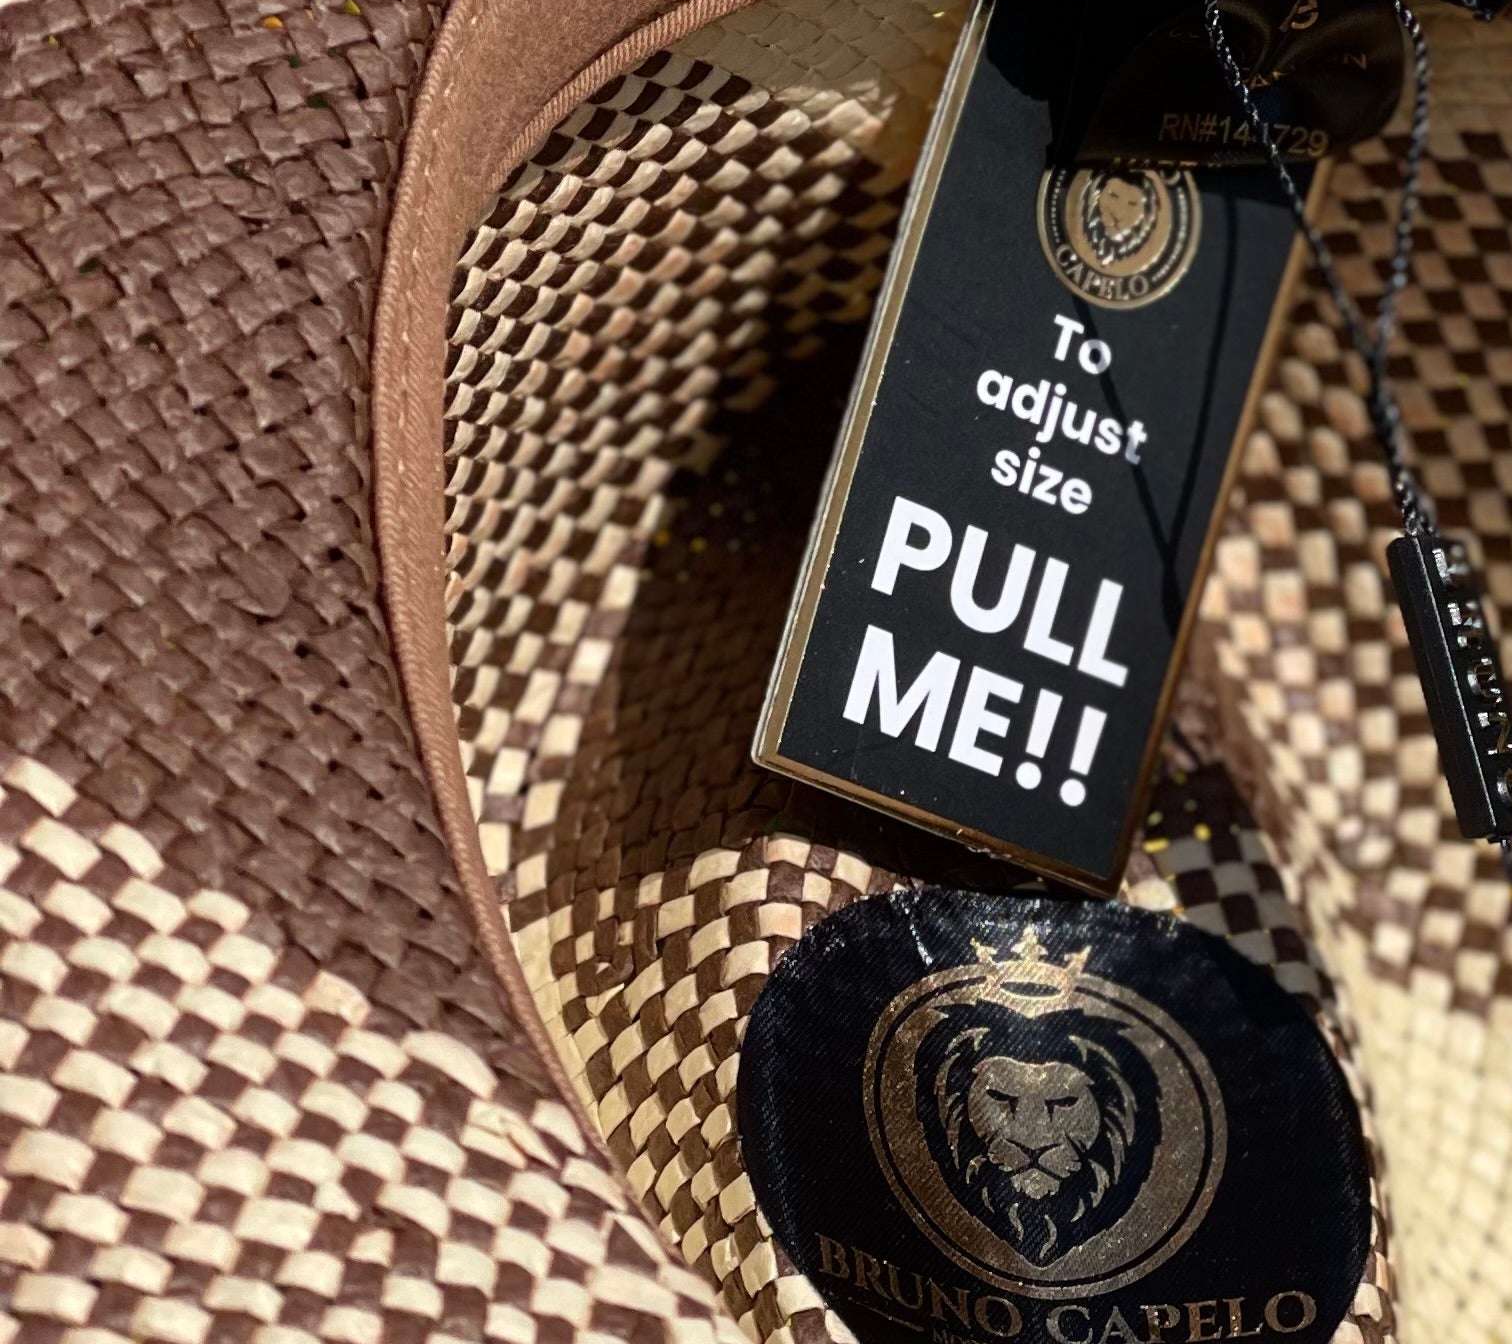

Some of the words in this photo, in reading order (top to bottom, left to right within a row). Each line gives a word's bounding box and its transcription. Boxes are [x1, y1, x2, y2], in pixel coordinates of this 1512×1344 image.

[1158, 112, 1328, 158] RN#14729
[1056, 244, 1149, 299] CAPELO
[1053, 314, 1111, 375] To
[977, 370, 1149, 464] adjust
[991, 447, 1092, 514] size
[871, 496, 1128, 687] PULL
[843, 624, 1107, 806] ME!!
[816, 1233, 1024, 1338] BRUNO
